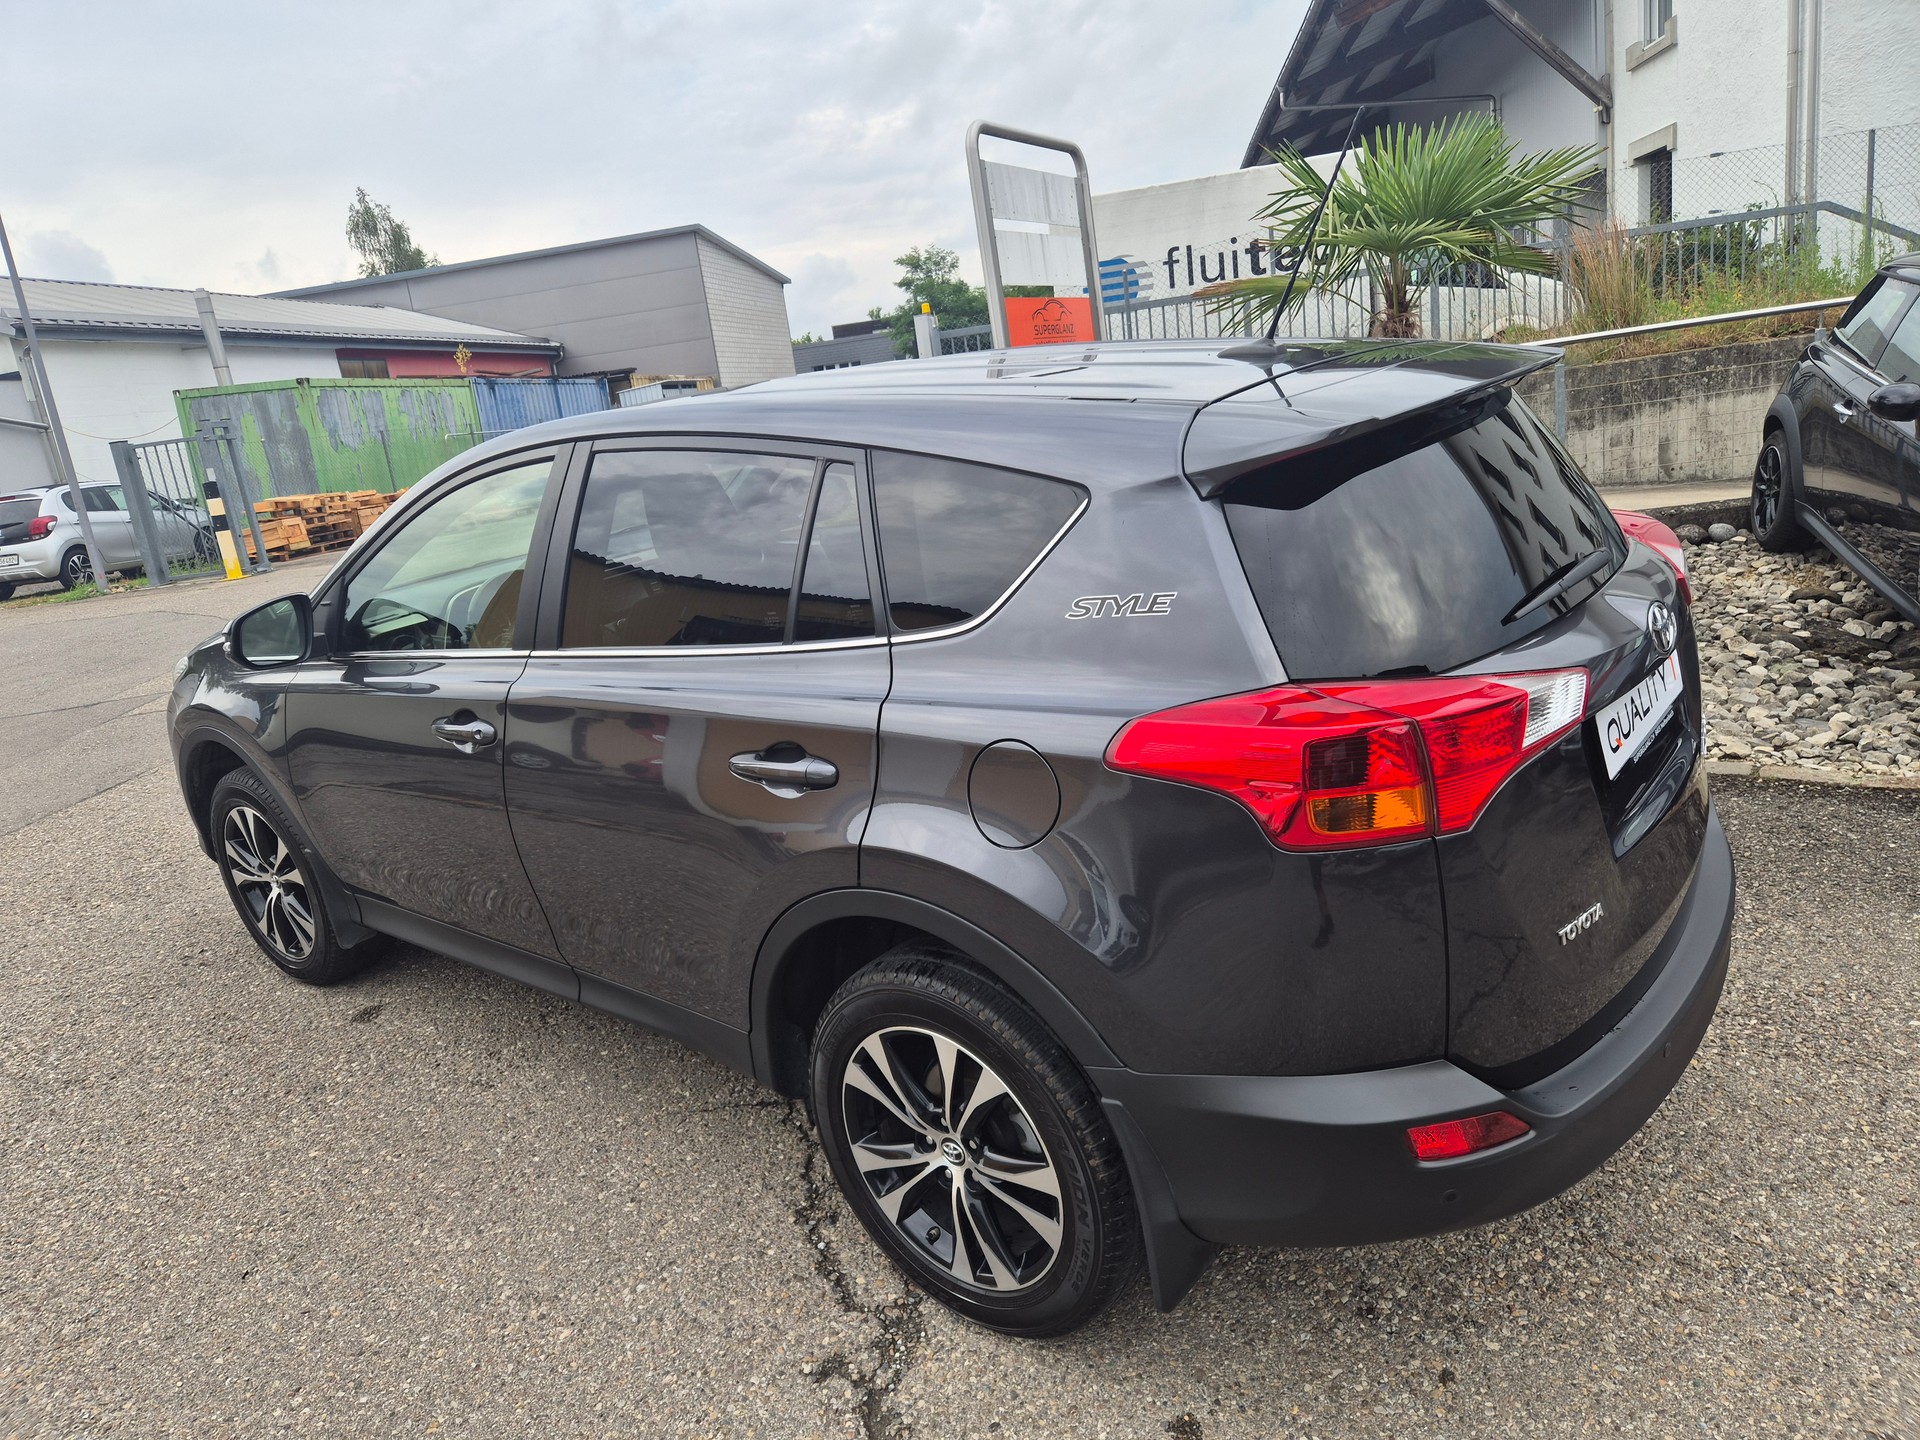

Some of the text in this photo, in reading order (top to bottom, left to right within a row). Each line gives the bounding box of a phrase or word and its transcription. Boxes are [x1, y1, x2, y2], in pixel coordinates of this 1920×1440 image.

[1033, 323, 1075, 336] SUPERGLANZ
[1065, 592, 1178, 619] STYLE
[1557, 902, 1604, 946] TOYOTA
